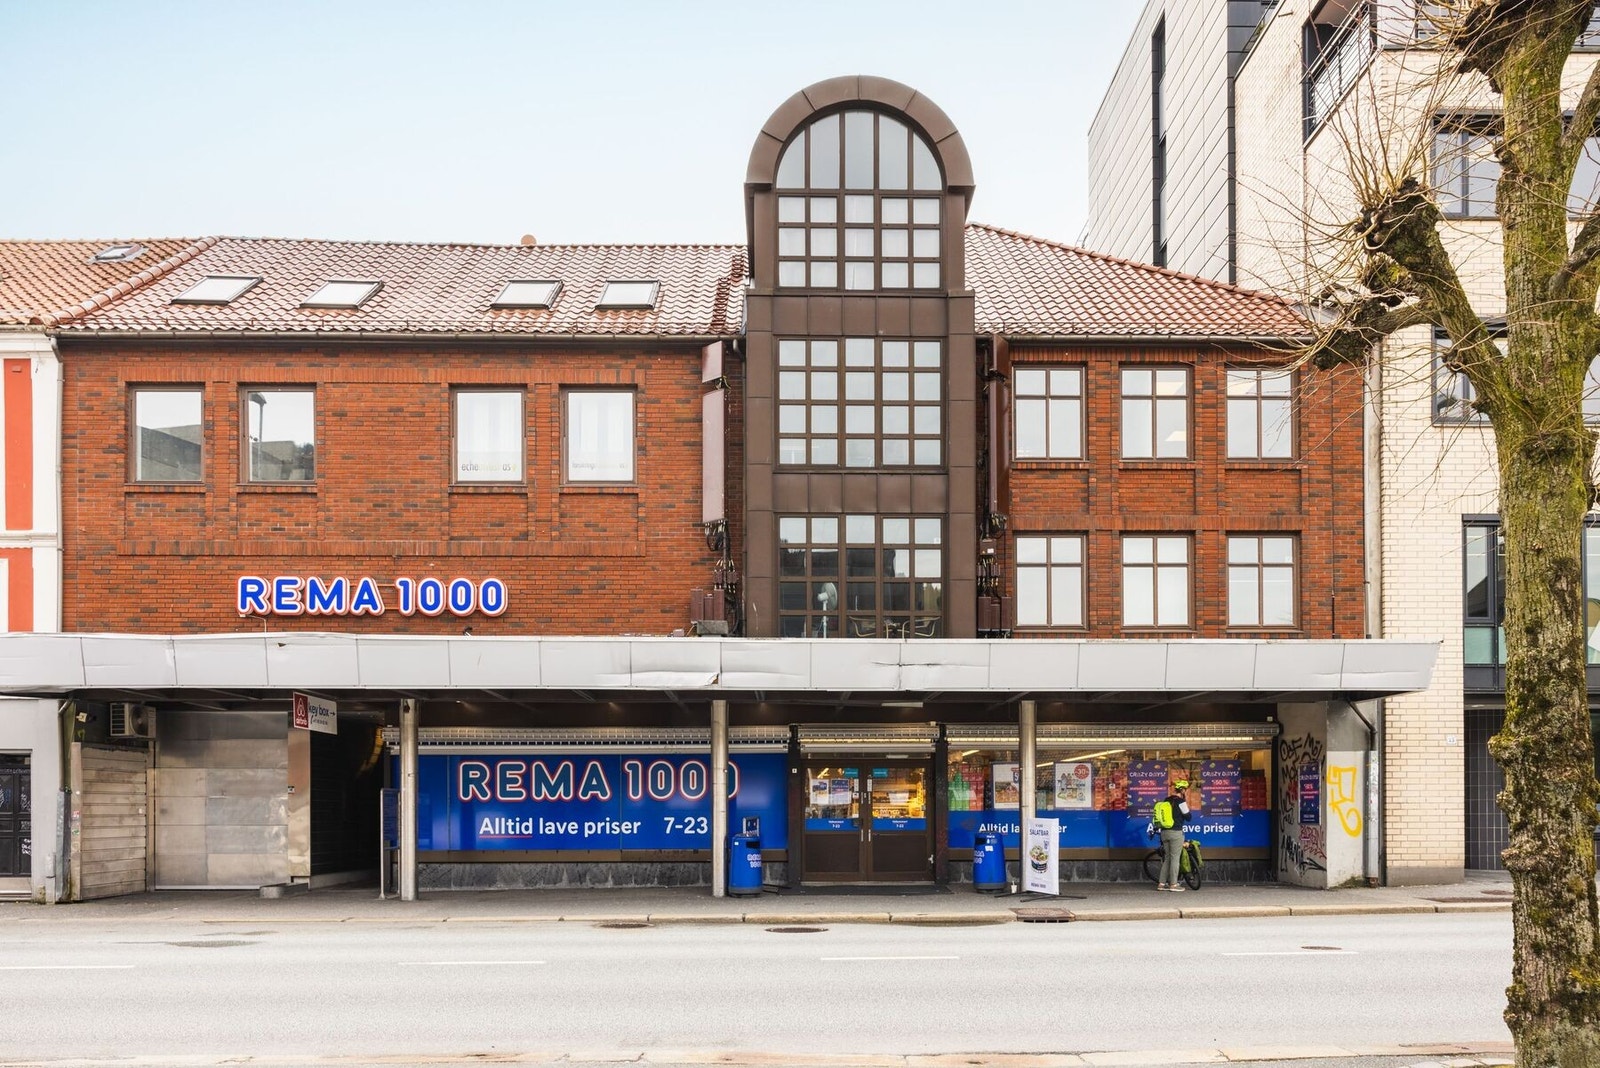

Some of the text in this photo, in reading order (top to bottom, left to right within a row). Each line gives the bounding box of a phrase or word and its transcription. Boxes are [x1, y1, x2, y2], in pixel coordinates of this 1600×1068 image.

[237, 576, 509, 617] REMA 1000
[458, 760, 612, 801] REMA
[479, 816, 709, 838] Alltid lave priser 7-23
[979, 823, 1009, 834] Alltid
[1182, 822, 1235, 834] ave priser
